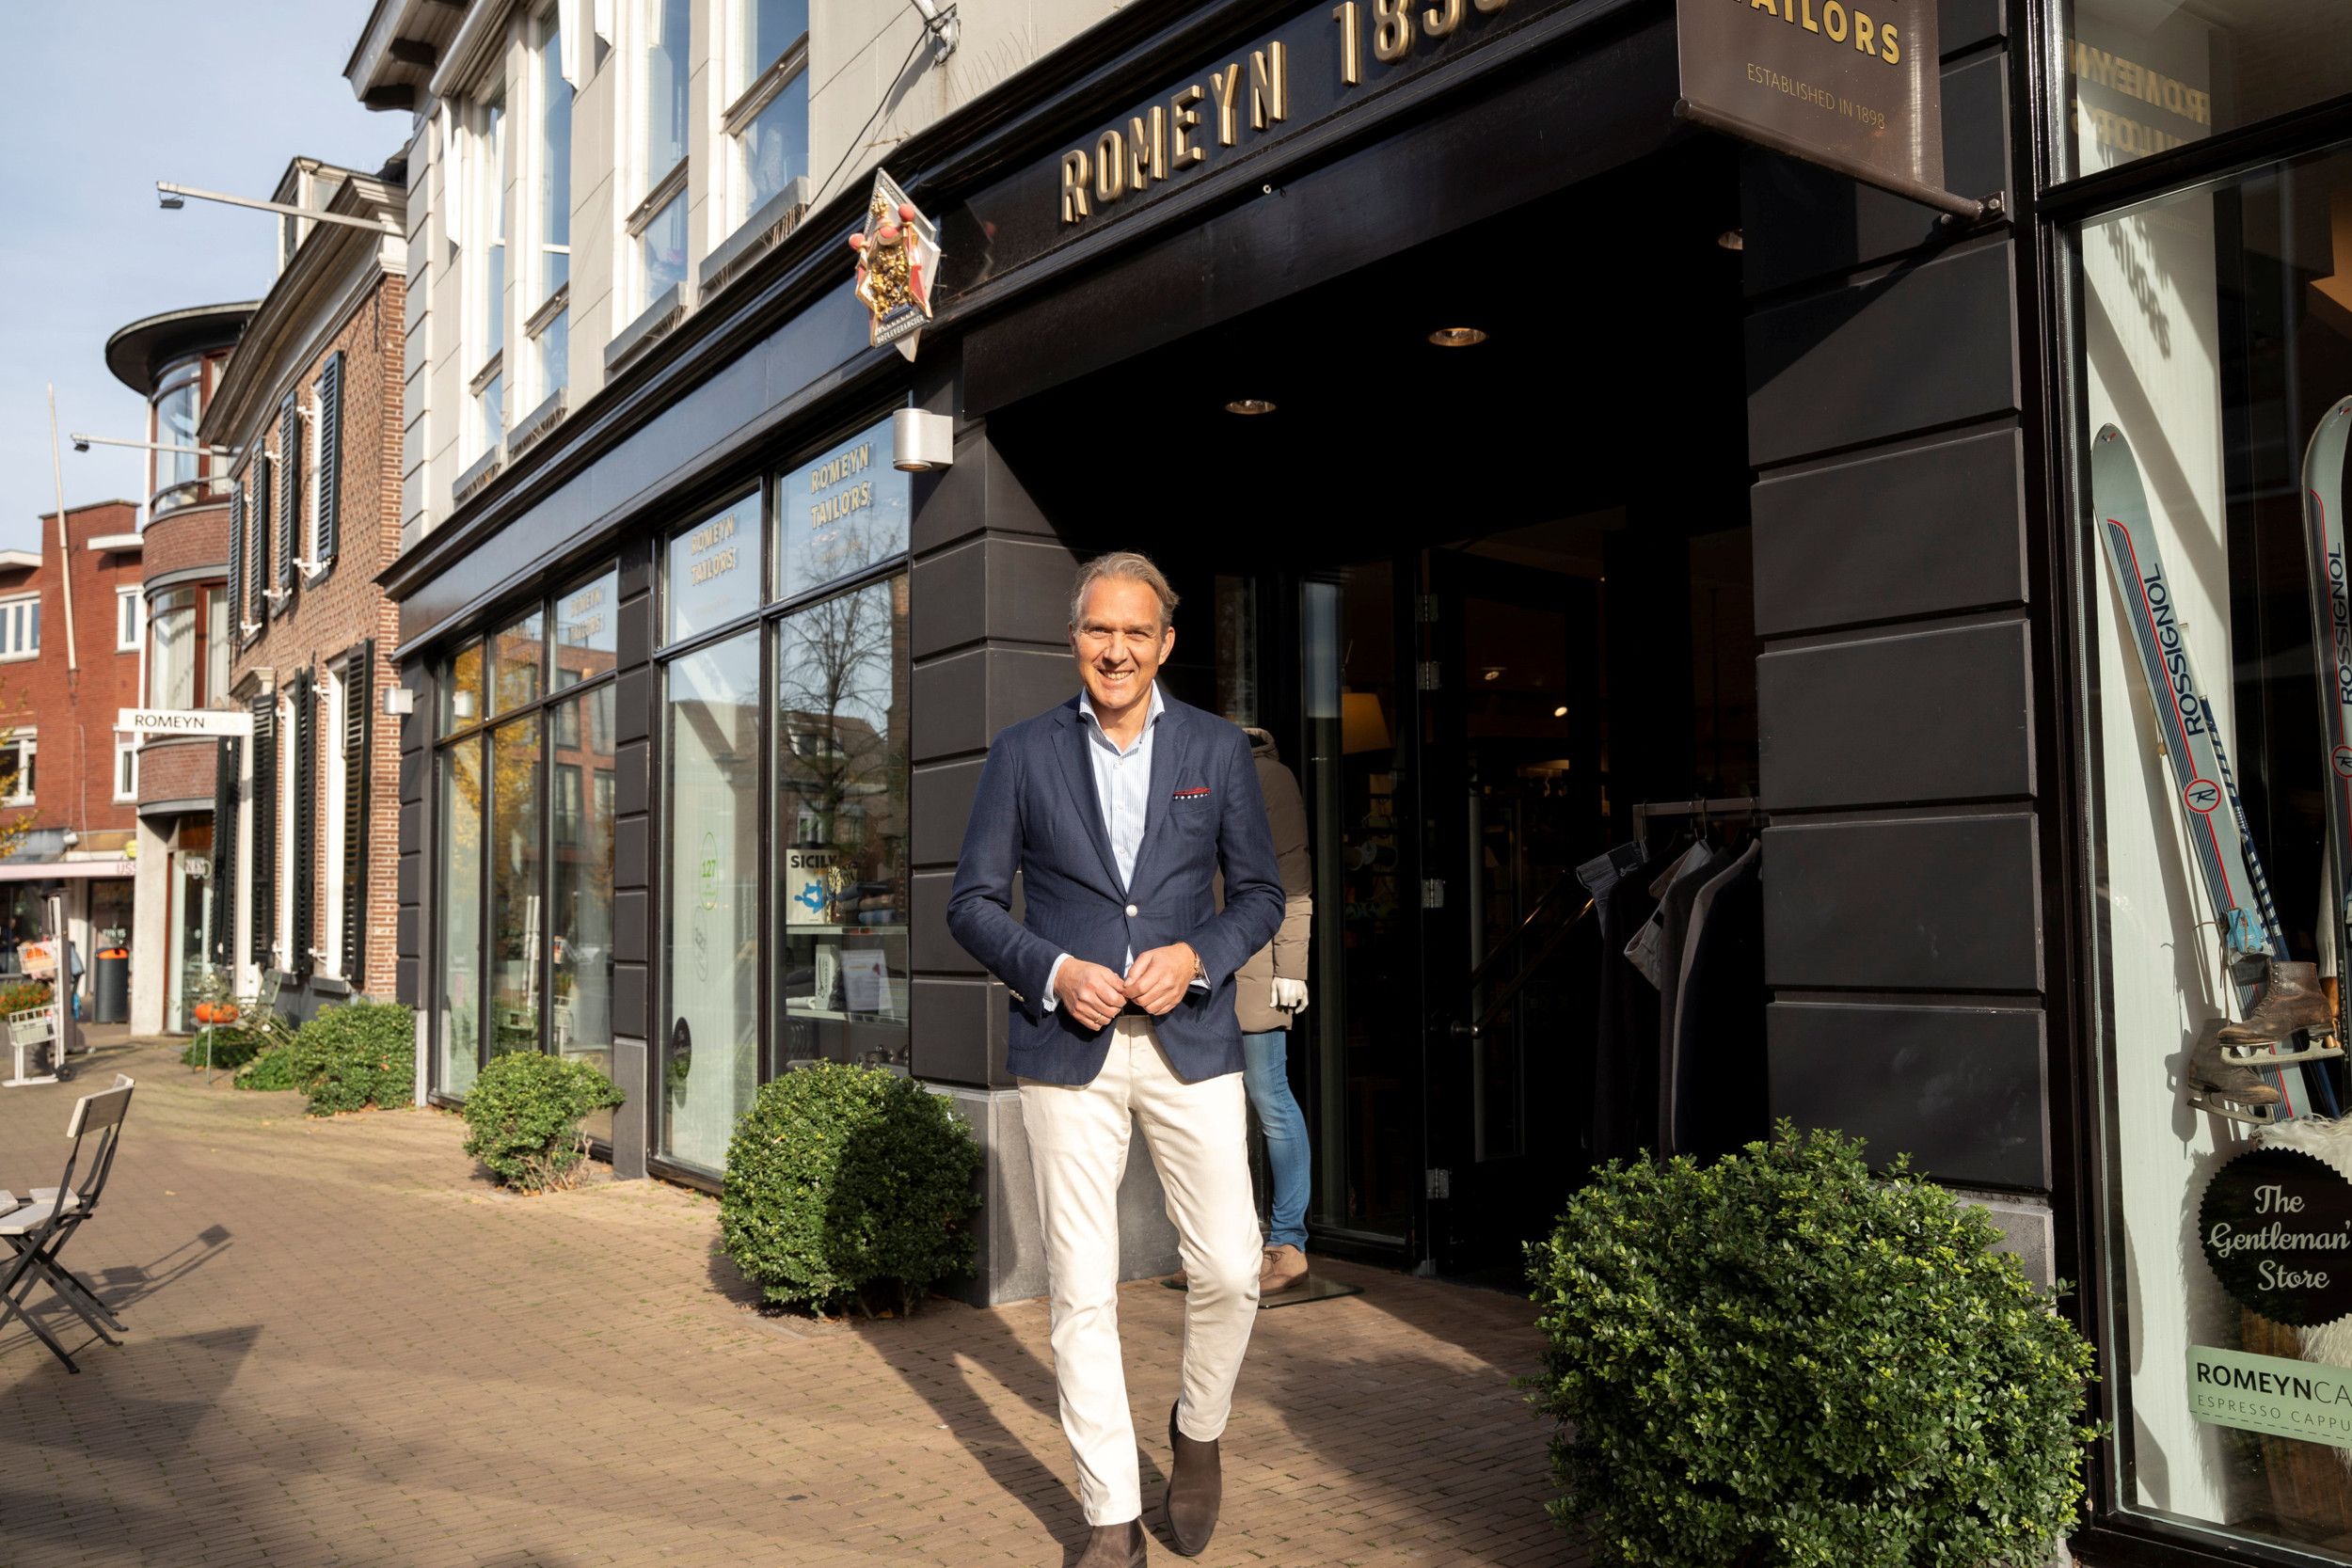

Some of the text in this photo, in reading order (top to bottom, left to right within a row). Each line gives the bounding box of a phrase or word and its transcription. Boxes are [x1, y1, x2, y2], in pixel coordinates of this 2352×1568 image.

[1733, 0, 1900, 65] ILORS
[1060, 0, 1505, 225] ROMEYN 18
[1746, 62, 1886, 130] ESTABLISHED IN 1898
[810, 442, 870, 495] ROMEYN
[810, 481, 871, 531] TAILORS
[691, 514, 736, 555] ROMEYN
[691, 548, 737, 586] TAILORS
[2328, 542, 2352, 705] ROSSIGNOL
[2143, 562, 2205, 736] ROSSIGNOL
[135, 715, 205, 728] ROMEYN
[2254, 1184, 2305, 1214] The
[2258, 1259, 2330, 1291] Store
[2198, 1394, 2351, 1432] ESPRESSO CAPPU
